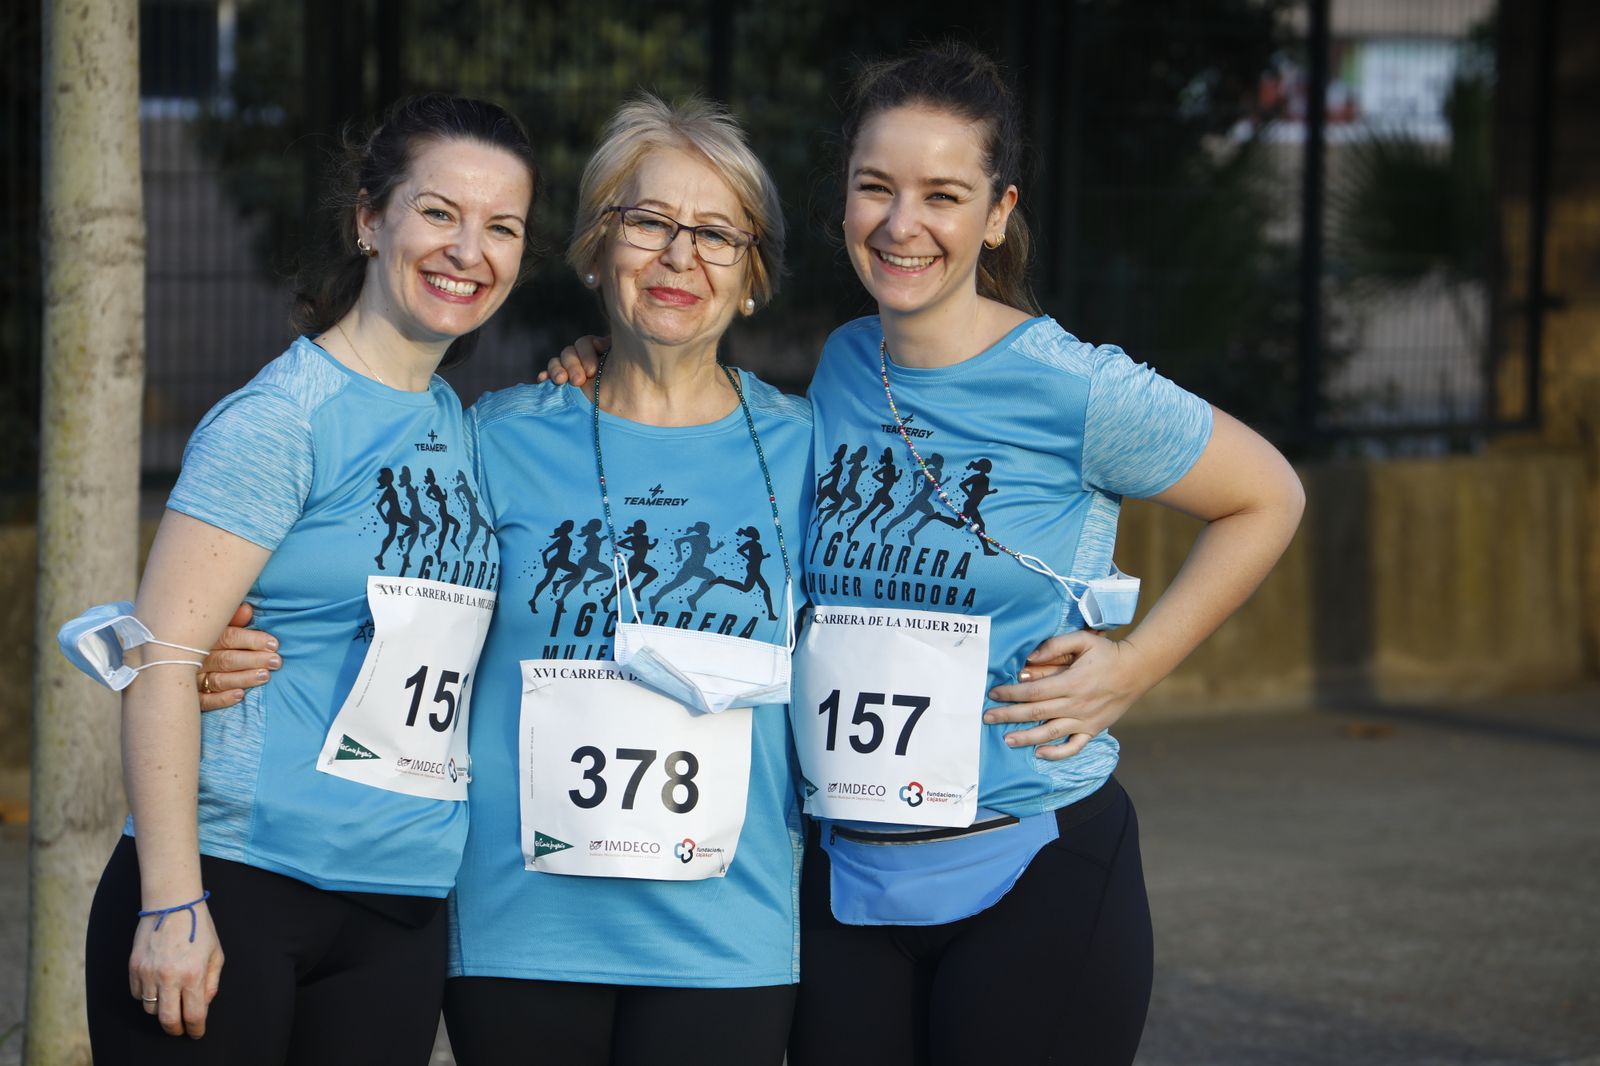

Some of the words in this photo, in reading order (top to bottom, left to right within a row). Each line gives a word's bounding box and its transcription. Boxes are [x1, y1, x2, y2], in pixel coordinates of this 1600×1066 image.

[624, 496, 688, 507] TEAMERGY
[843, 540, 972, 580] CARRERA
[404, 585, 452, 602] CARRERA
[453, 592, 465, 605] DE
[466, 595, 476, 607] LA
[874, 573, 977, 608] CÓRDOBA
[813, 613, 866, 626] CARRERA
[868, 615, 883, 627] DE
[886, 616, 902, 628] LA
[904, 618, 950, 632] MUJER
[953, 622, 979, 634] 2021
[533, 667, 557, 680] XVI
[560, 668, 625, 682] CARRERA
[818, 689, 931, 756] 157
[568, 745, 700, 815] 378
[838, 783, 886, 797] IMDECO
[604, 839, 661, 854] IMDECO
